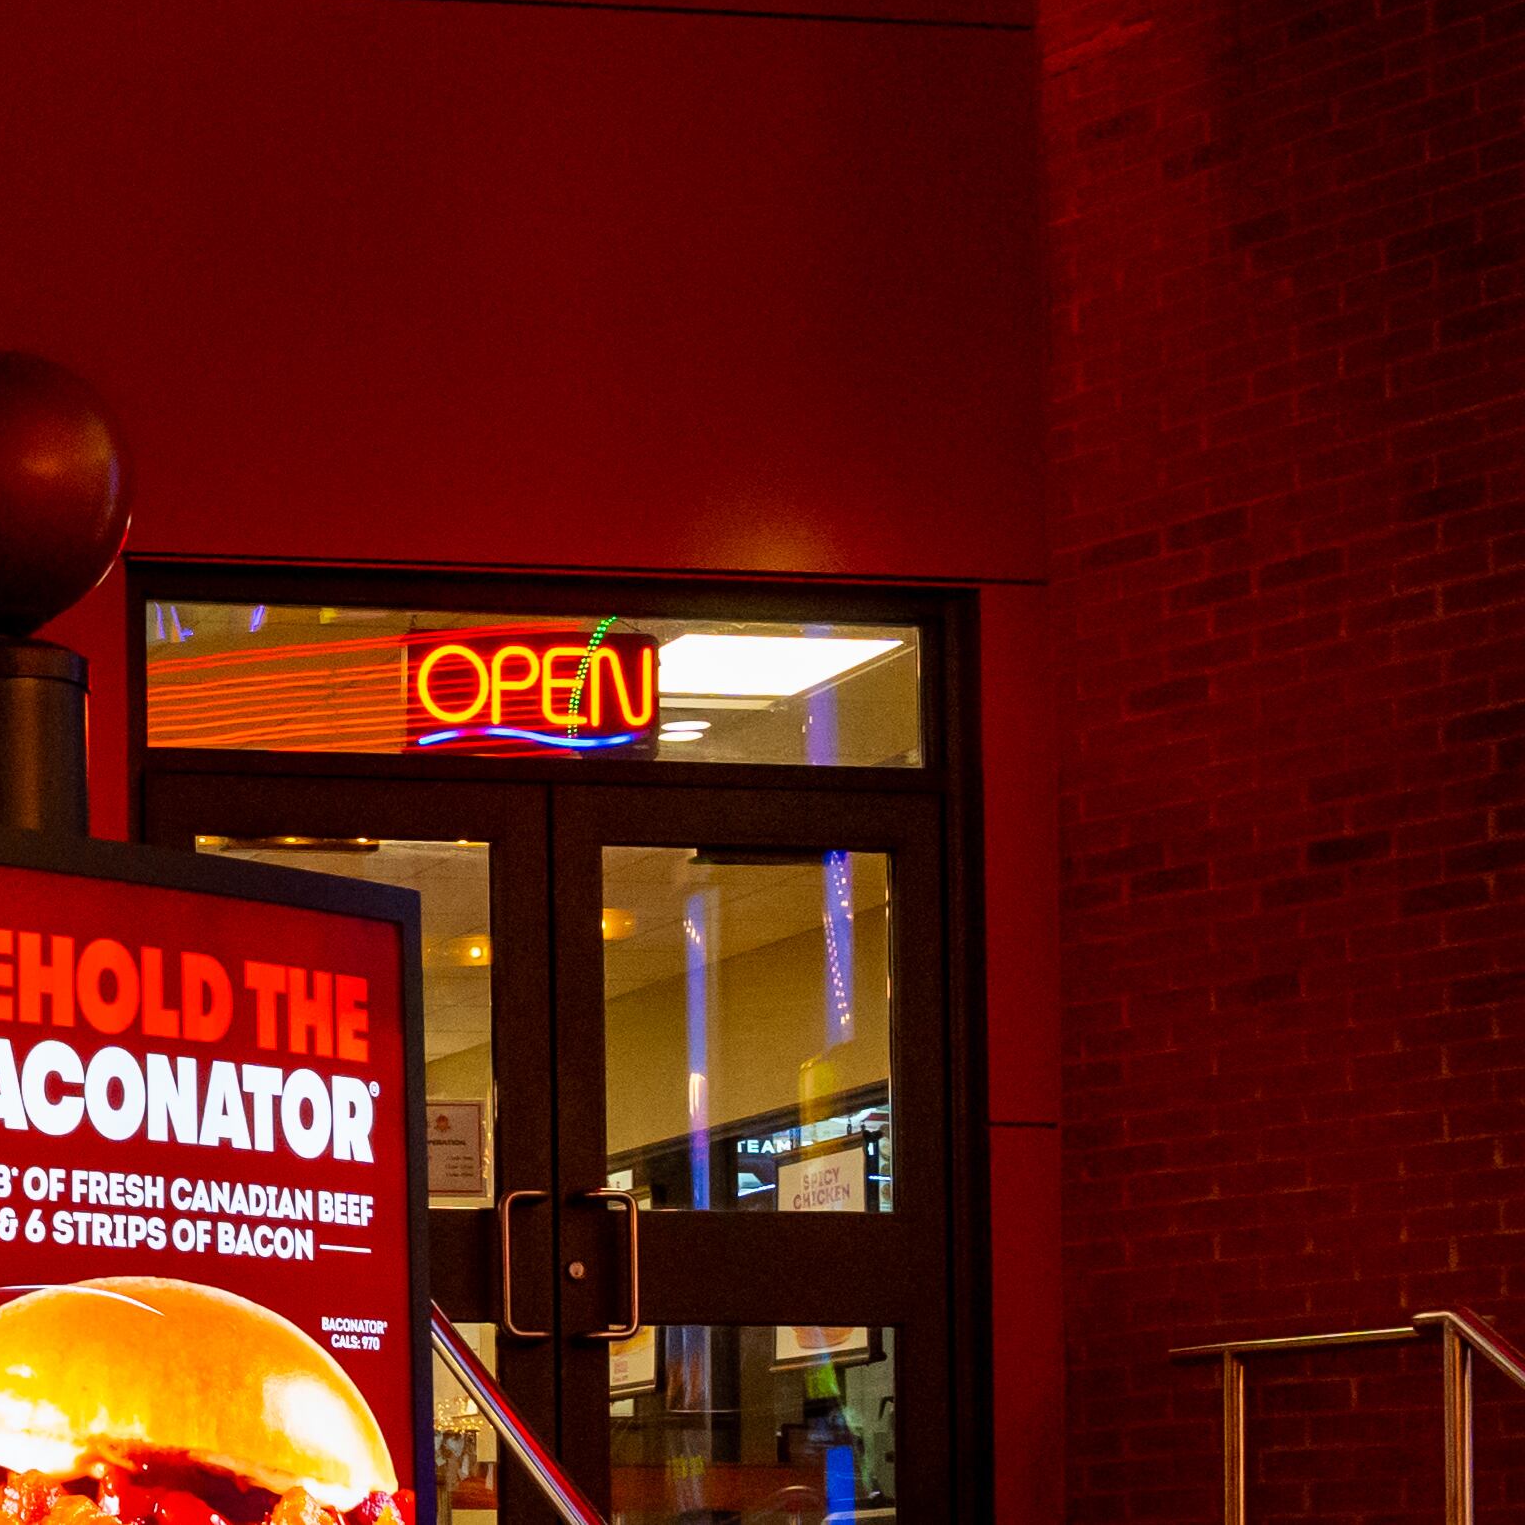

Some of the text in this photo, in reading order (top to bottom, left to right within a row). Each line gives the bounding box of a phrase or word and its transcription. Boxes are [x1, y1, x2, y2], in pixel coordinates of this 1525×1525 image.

[418, 645, 652, 727] OPEN
[243, 960, 369, 1063] THE
[23, 1166, 66, 1202] OF
[71, 1169, 165, 1209] FRESH
[170, 1177, 314, 1221] CANADIAN
[317, 1190, 374, 1227] BEEF
[793, 1183, 851, 1210] CHICKEN
[802, 1167, 841, 1191] SPICY
[24, 1208, 46, 1243] 6
[52, 1210, 167, 1251] STRIPS
[171, 1218, 212, 1253] OF
[217, 1221, 314, 1261] BACON
[331, 1334, 381, 1351] CALS: 970
